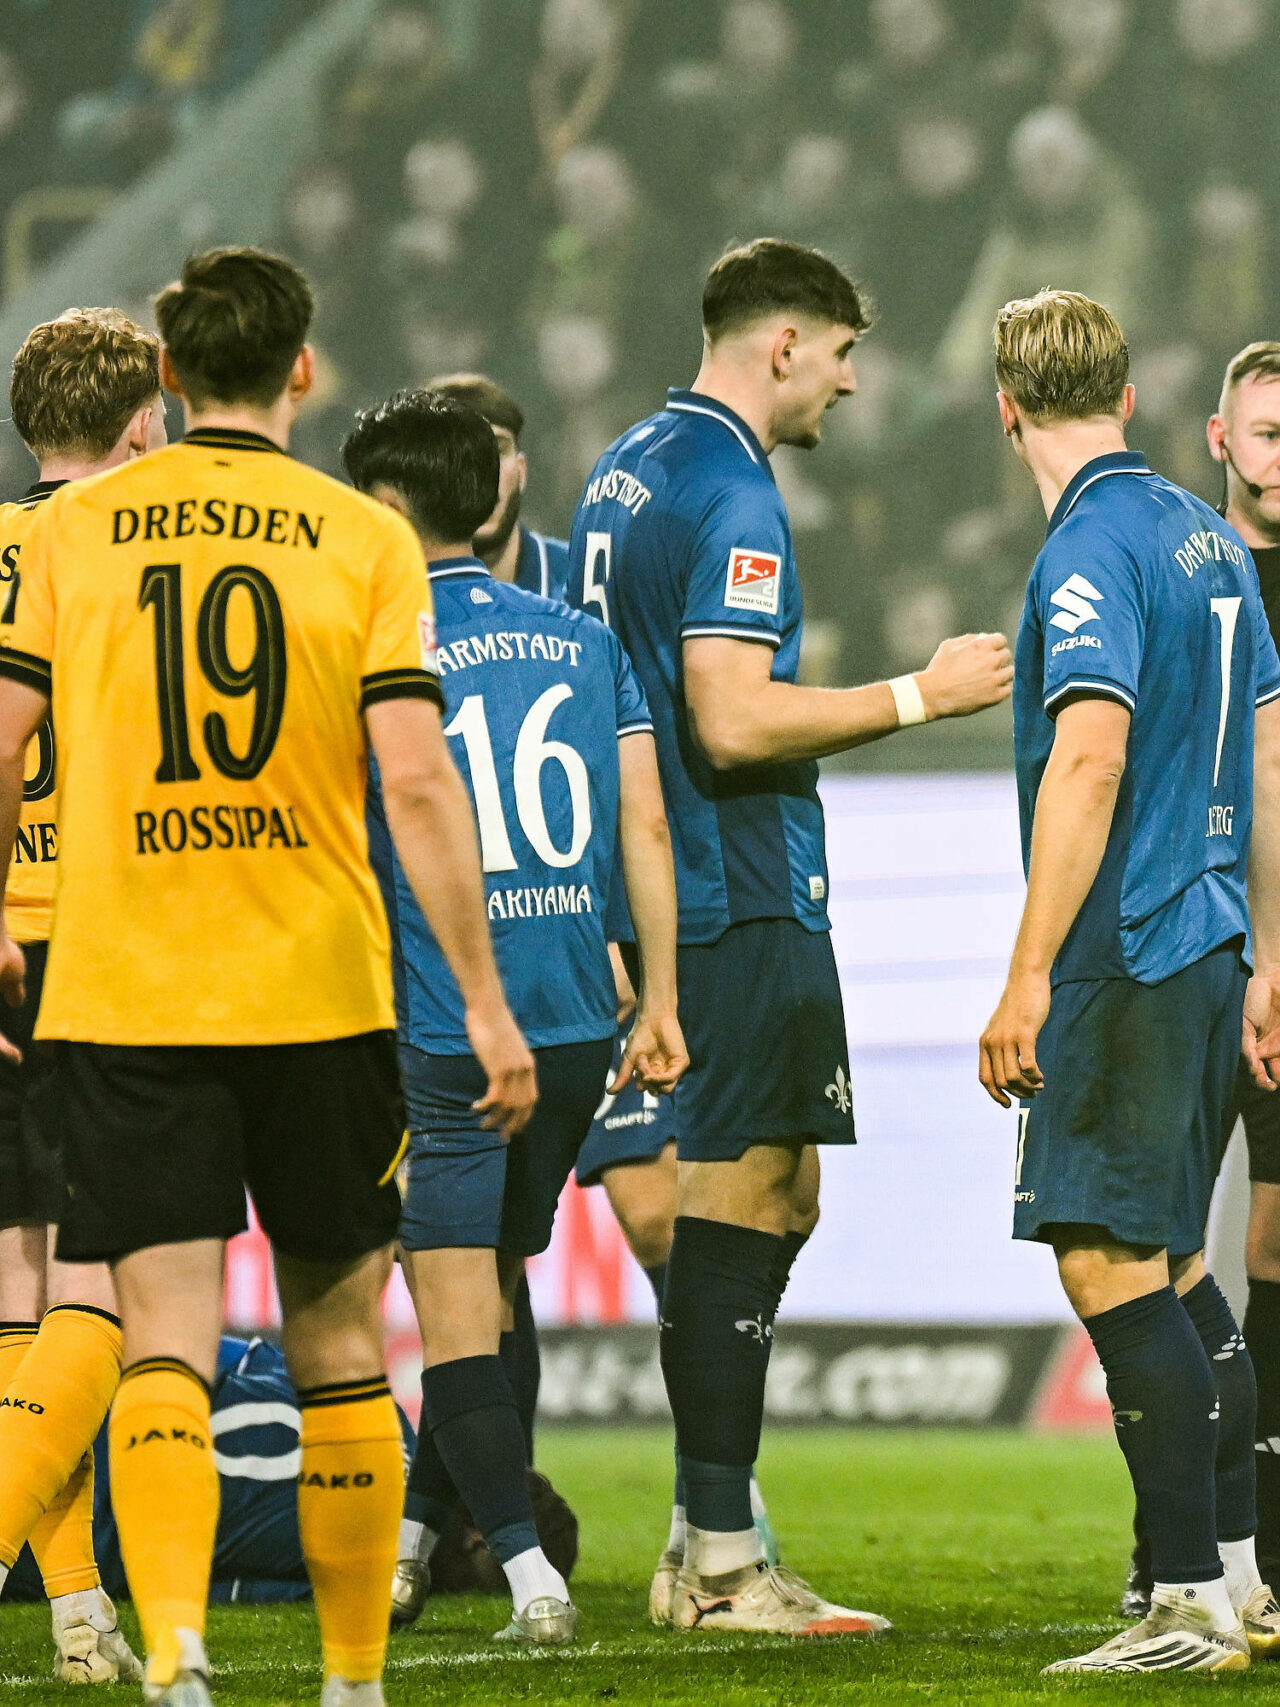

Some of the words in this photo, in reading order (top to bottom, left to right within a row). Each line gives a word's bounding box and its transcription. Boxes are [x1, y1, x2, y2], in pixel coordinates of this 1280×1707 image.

[111, 499, 325, 549] DRESDEN
[436, 632, 582, 677] ARMSTADT
[1051, 634, 1102, 657] SUZUKI
[138, 564, 288, 784] 19
[443, 683, 593, 875] 16
[134, 805, 309, 855] ROSSIPAL
[488, 884, 593, 920] AKIYAMA
[0, 1397, 45, 1415] AKO
[123, 1428, 205, 1451] JAKO
